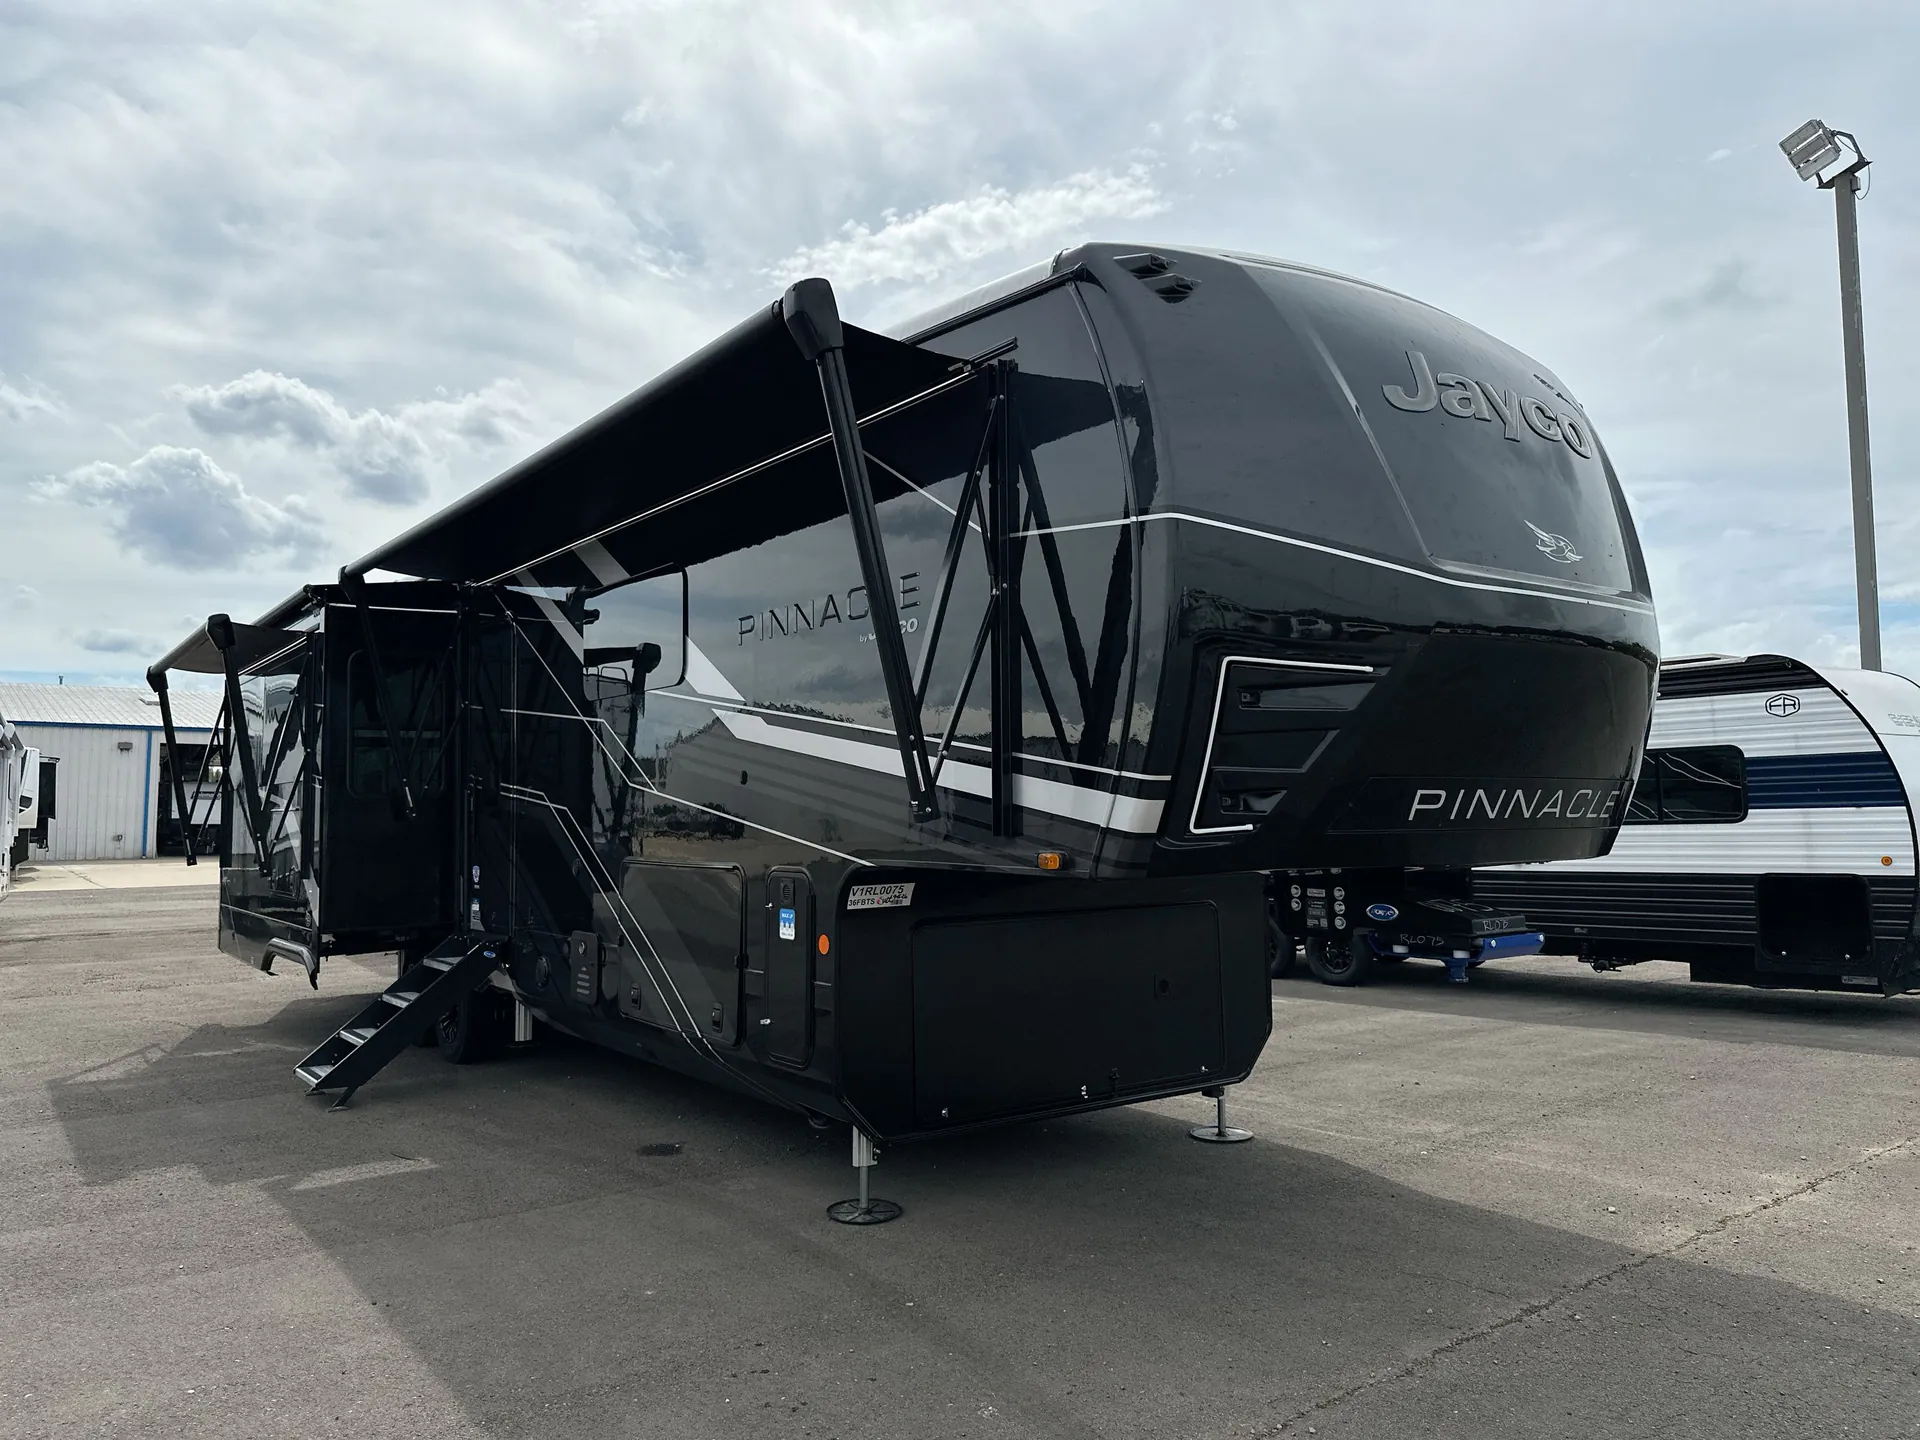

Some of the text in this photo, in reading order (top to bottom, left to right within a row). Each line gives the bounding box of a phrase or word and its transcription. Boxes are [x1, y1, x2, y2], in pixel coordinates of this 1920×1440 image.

[1381, 350, 1592, 460] Jayco
[738, 571, 920, 646] PINNACE
[1408, 789, 1620, 821] PINNACLE
[851, 885, 905, 896] V1RL0075
